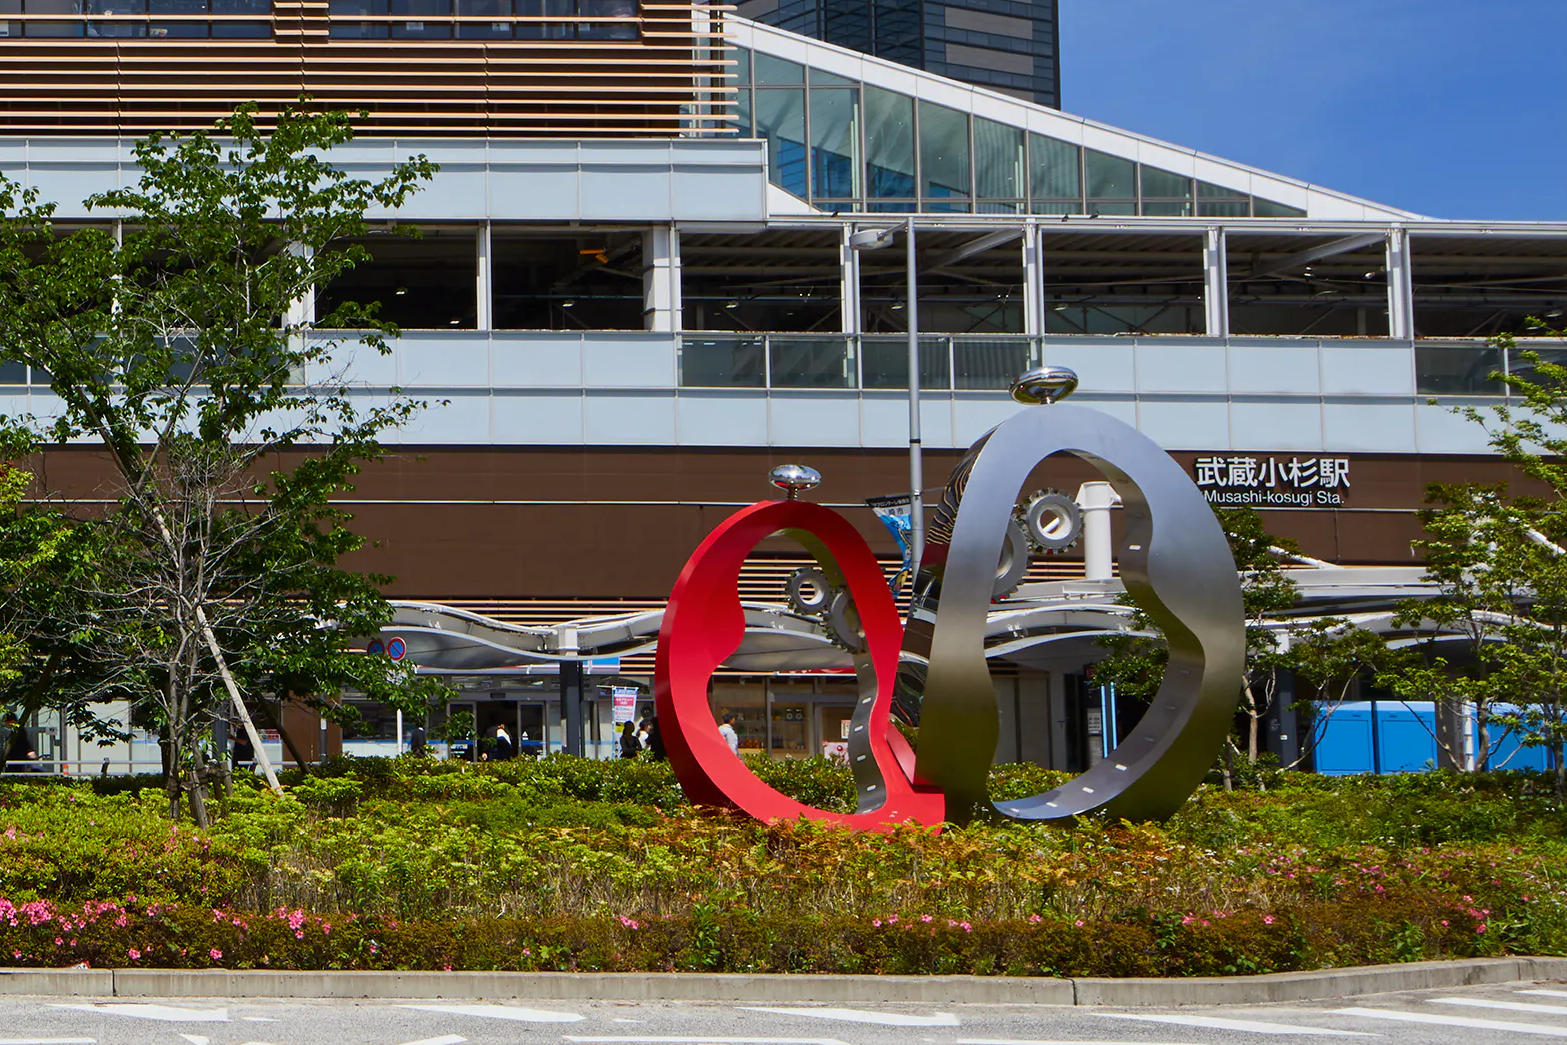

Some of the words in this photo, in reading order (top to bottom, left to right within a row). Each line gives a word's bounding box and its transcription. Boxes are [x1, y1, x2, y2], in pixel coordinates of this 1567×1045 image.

[1196, 457, 1350, 488] 武蔵小杉駅
[1204, 490, 1313, 506] Musashi-kosugi
[1317, 491, 1344, 504] Sta.
